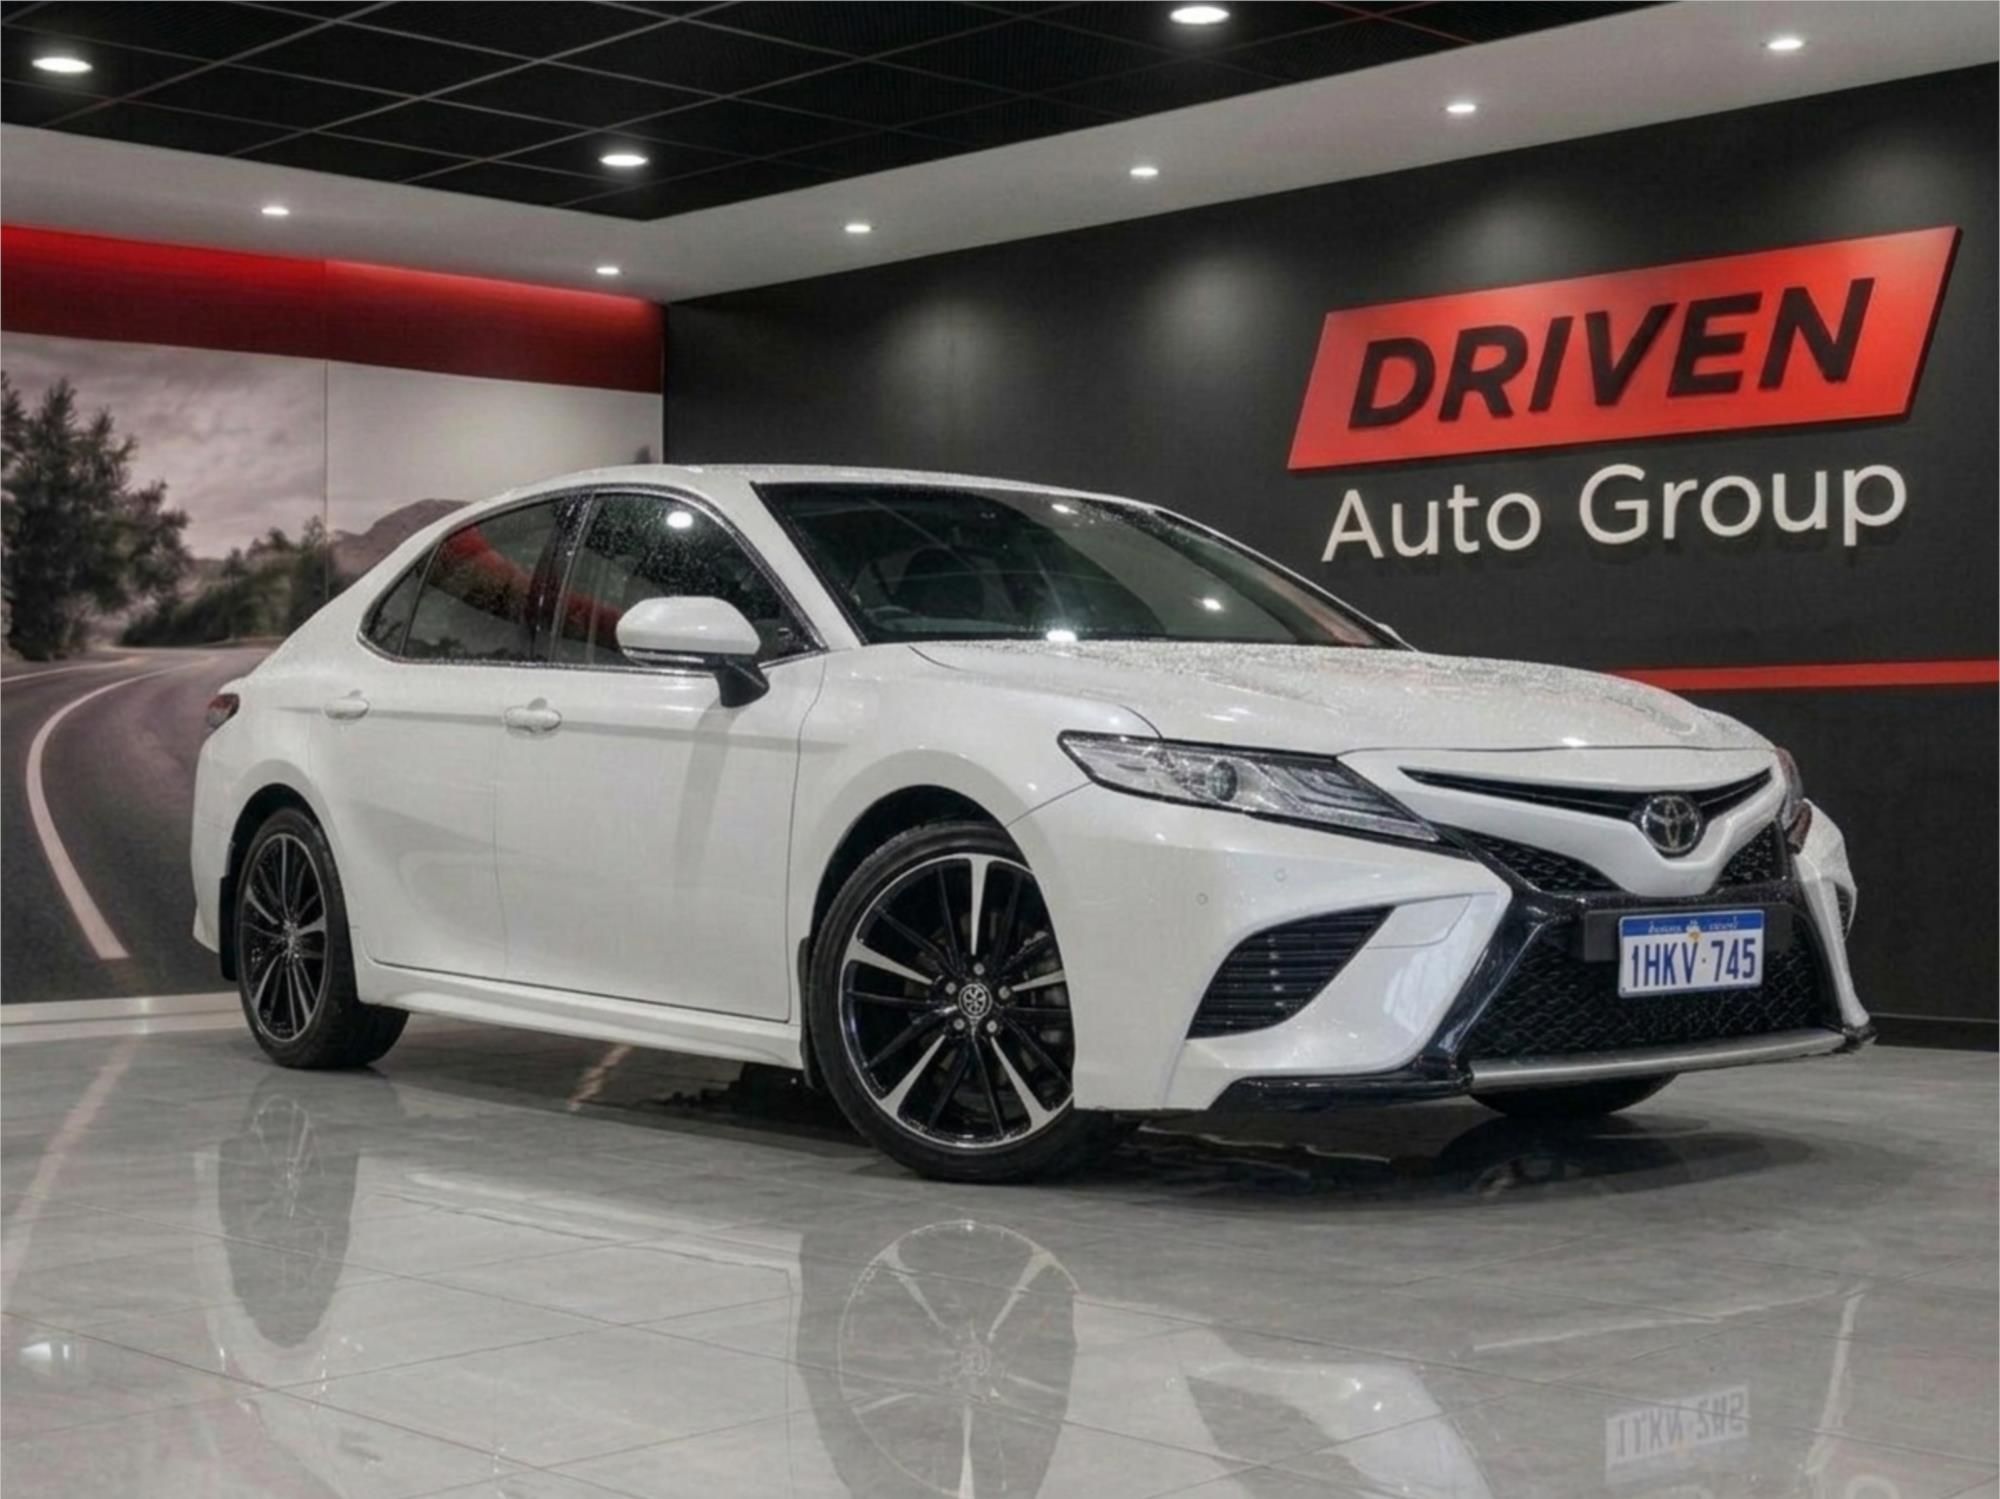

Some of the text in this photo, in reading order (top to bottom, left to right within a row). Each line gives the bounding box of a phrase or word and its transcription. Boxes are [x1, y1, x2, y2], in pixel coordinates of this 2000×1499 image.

[1347, 277, 1875, 429] DRIVEN
[1321, 464, 1907, 562] Auto Group
